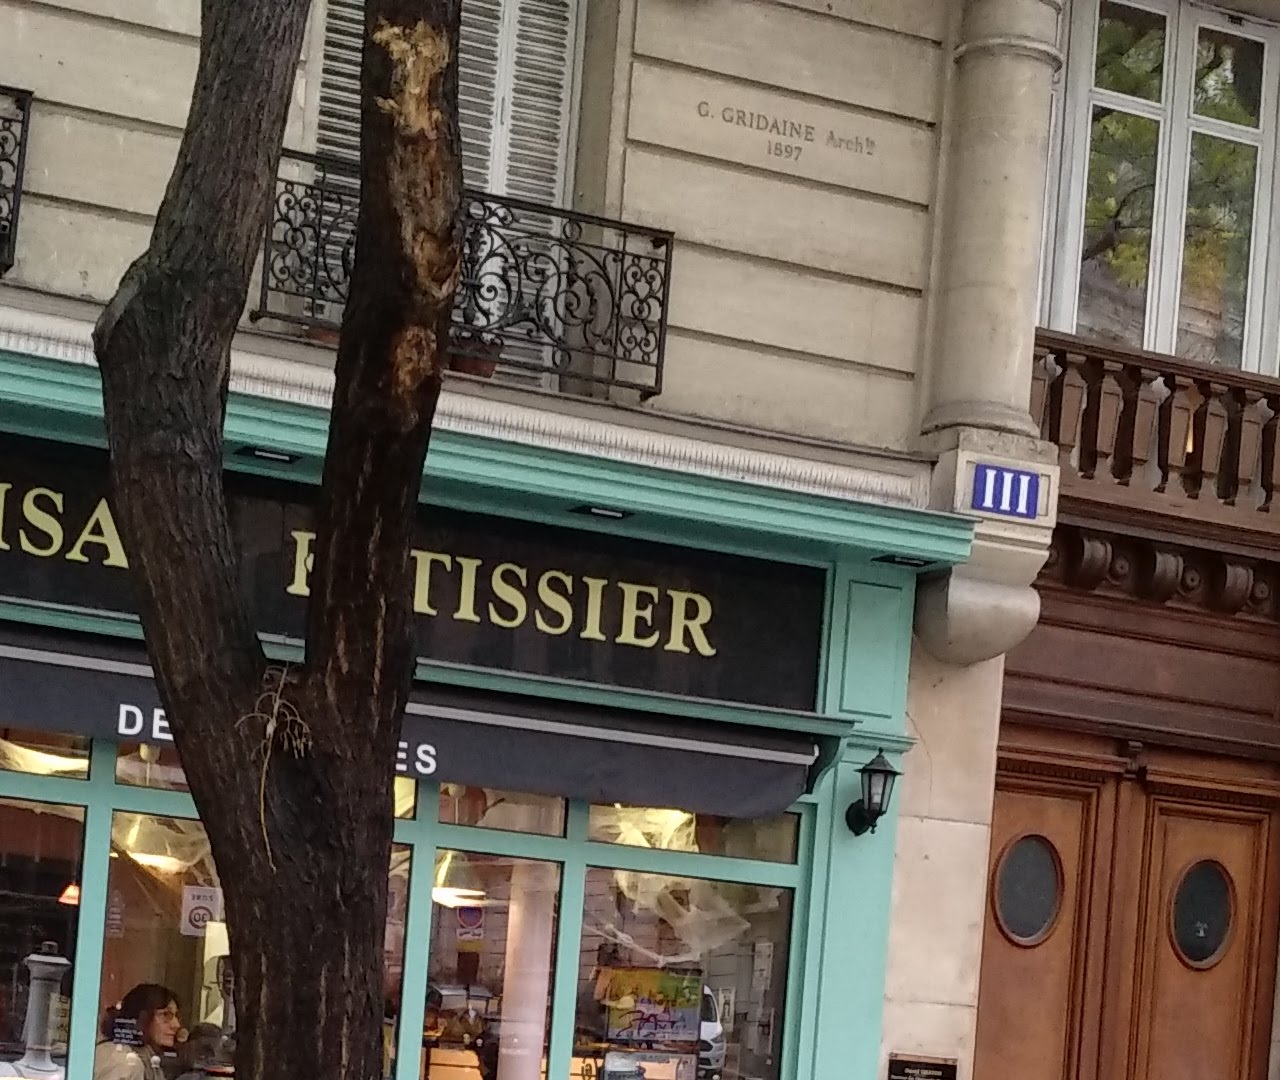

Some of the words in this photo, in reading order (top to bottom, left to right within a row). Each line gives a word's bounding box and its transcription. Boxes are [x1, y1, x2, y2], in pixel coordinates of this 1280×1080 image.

[721, 107, 815, 142] GRIDAINE
[767, 140, 803, 161] 1897
[286, 530, 717, 657] PTISSIER
[118, 703, 174, 742] DE
